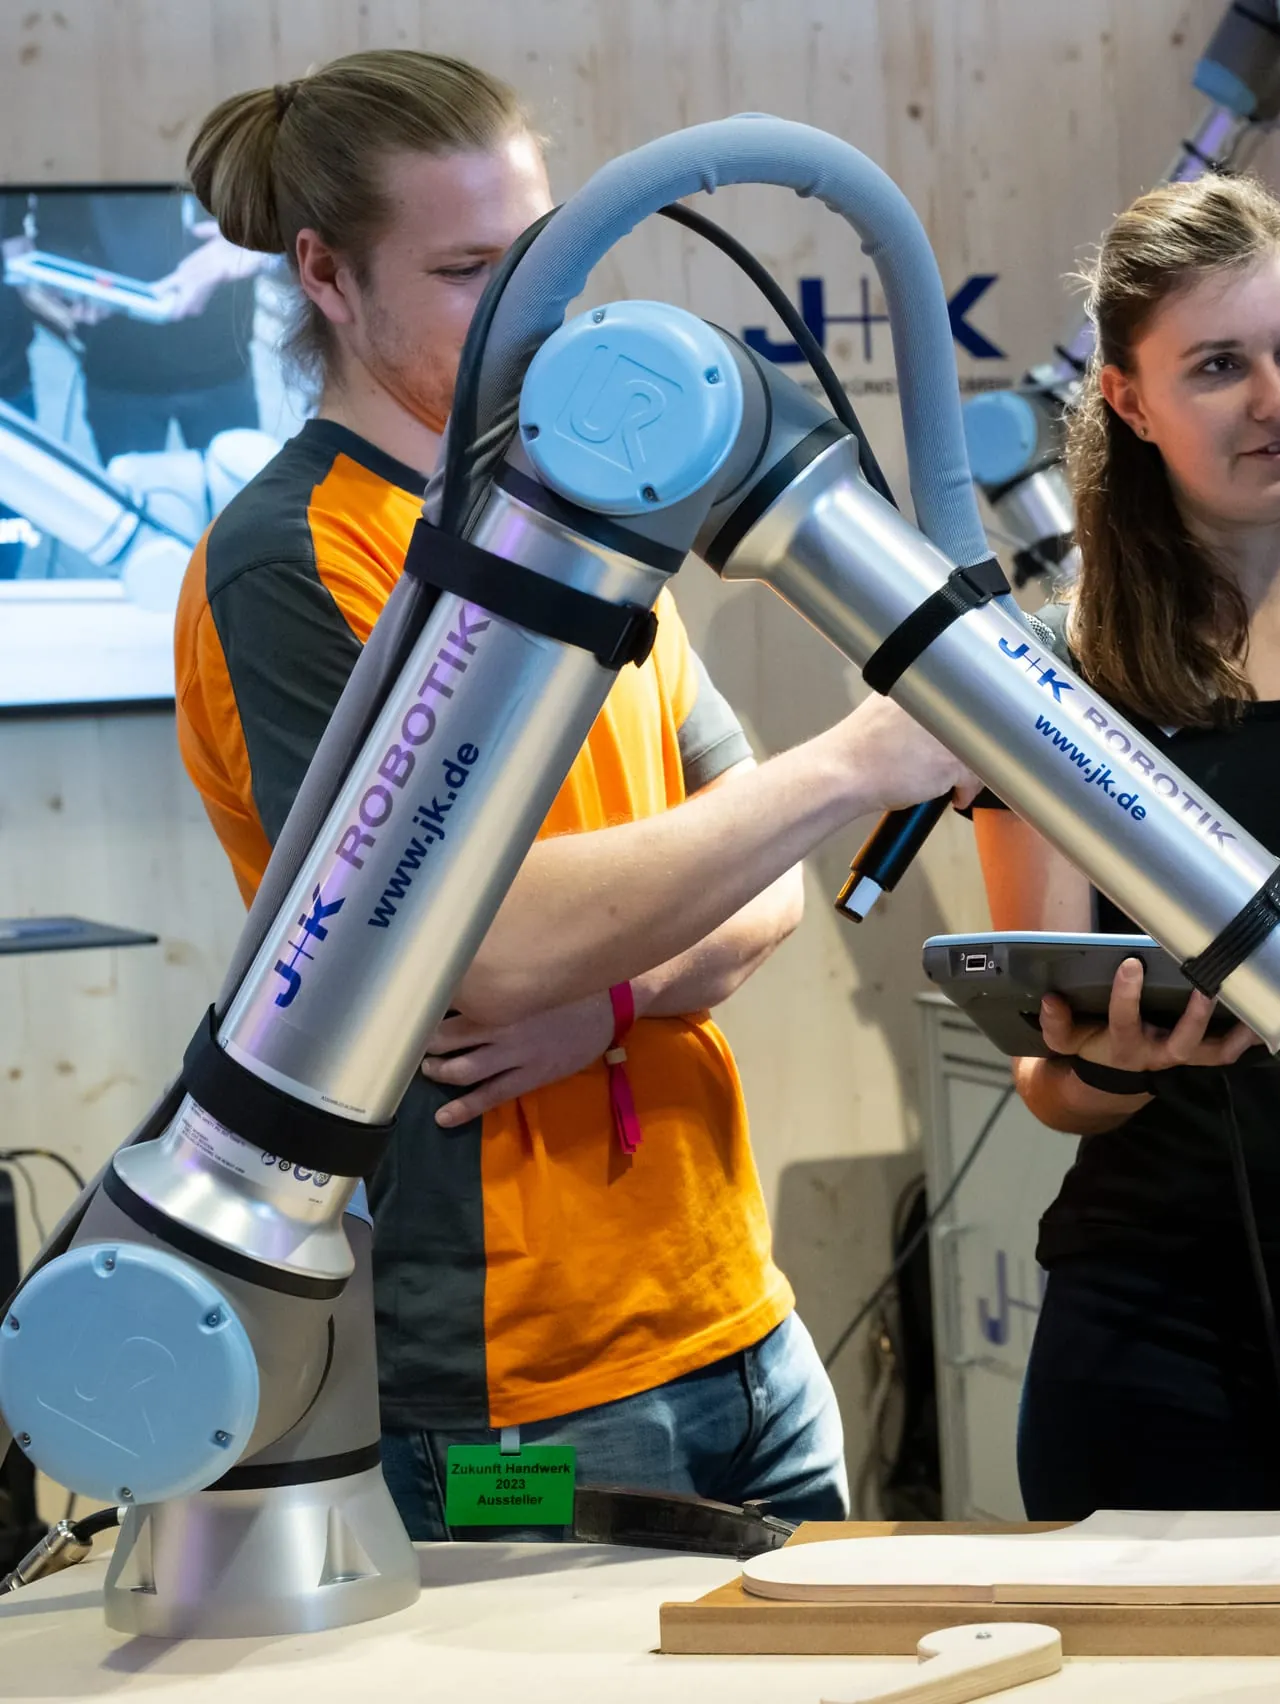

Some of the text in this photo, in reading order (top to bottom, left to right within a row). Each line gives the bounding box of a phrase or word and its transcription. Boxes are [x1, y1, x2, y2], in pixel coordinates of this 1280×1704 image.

[998, 637, 1074, 704] J+K
[1034, 714, 1147, 821] www.jk.de
[274, 882, 346, 1009] J+K
[335, 605, 492, 870] ROBOTIK
[367, 742, 480, 930] www.jk.de
[451, 1463, 571, 1475] Zukunft Handwerk
[477, 1494, 544, 1506] Aussteller
[495, 1478, 526, 1490] 2023
